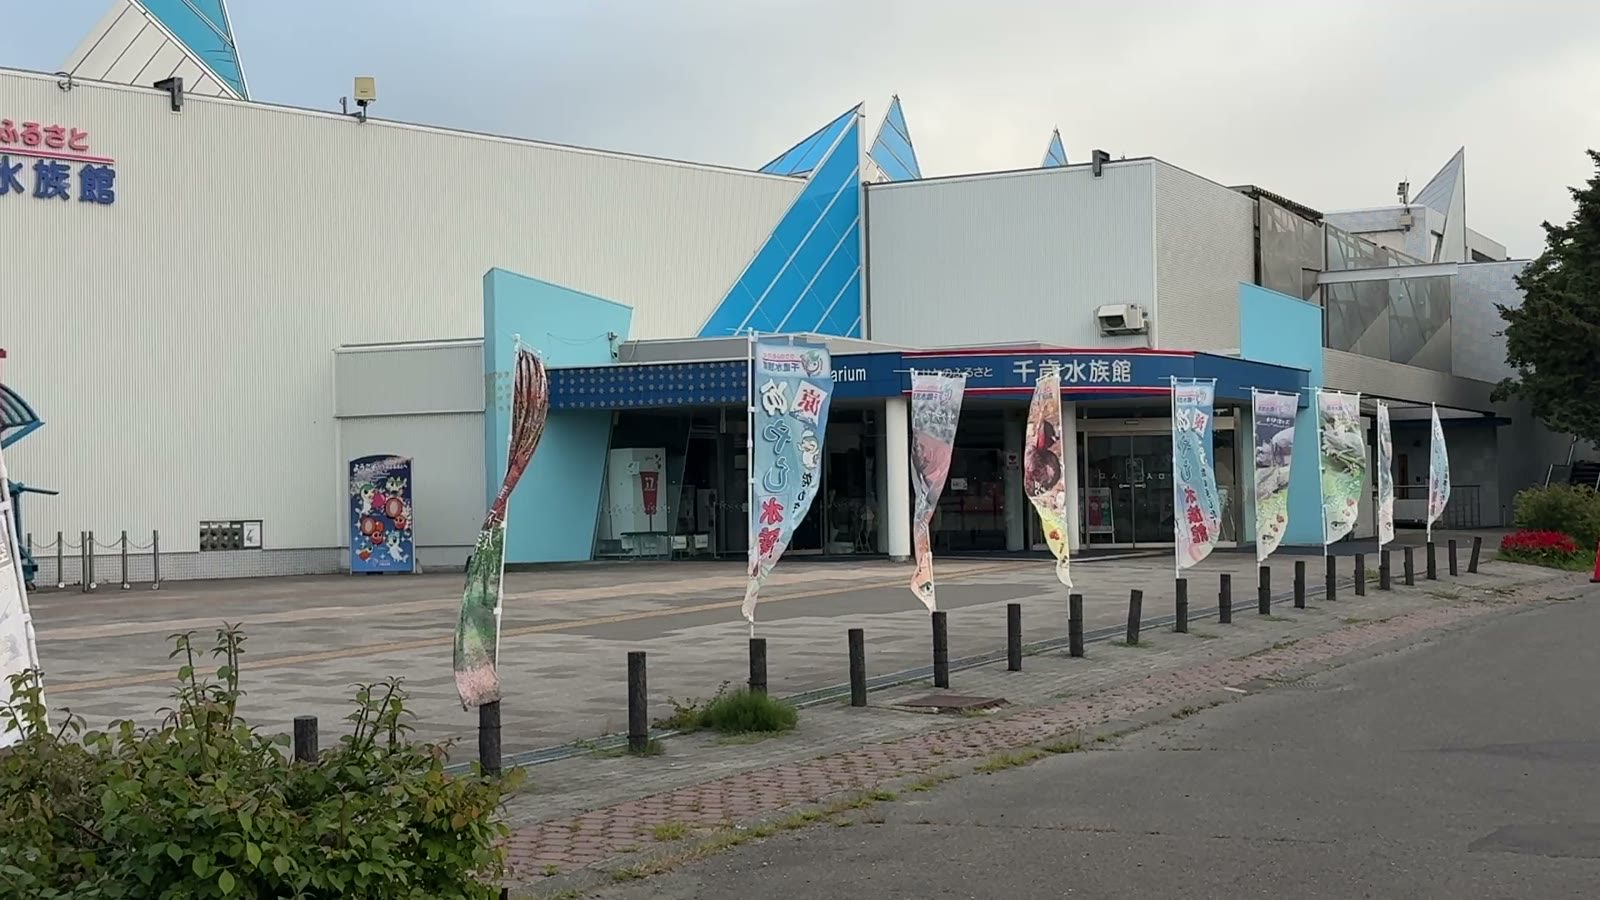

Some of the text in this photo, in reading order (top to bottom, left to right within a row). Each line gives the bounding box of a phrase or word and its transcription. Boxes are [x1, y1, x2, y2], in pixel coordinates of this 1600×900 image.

[0, 119, 88, 151] ふるさと
[0, 156, 115, 204] 水族館
[1012, 359, 1131, 383] 千歳水族館
